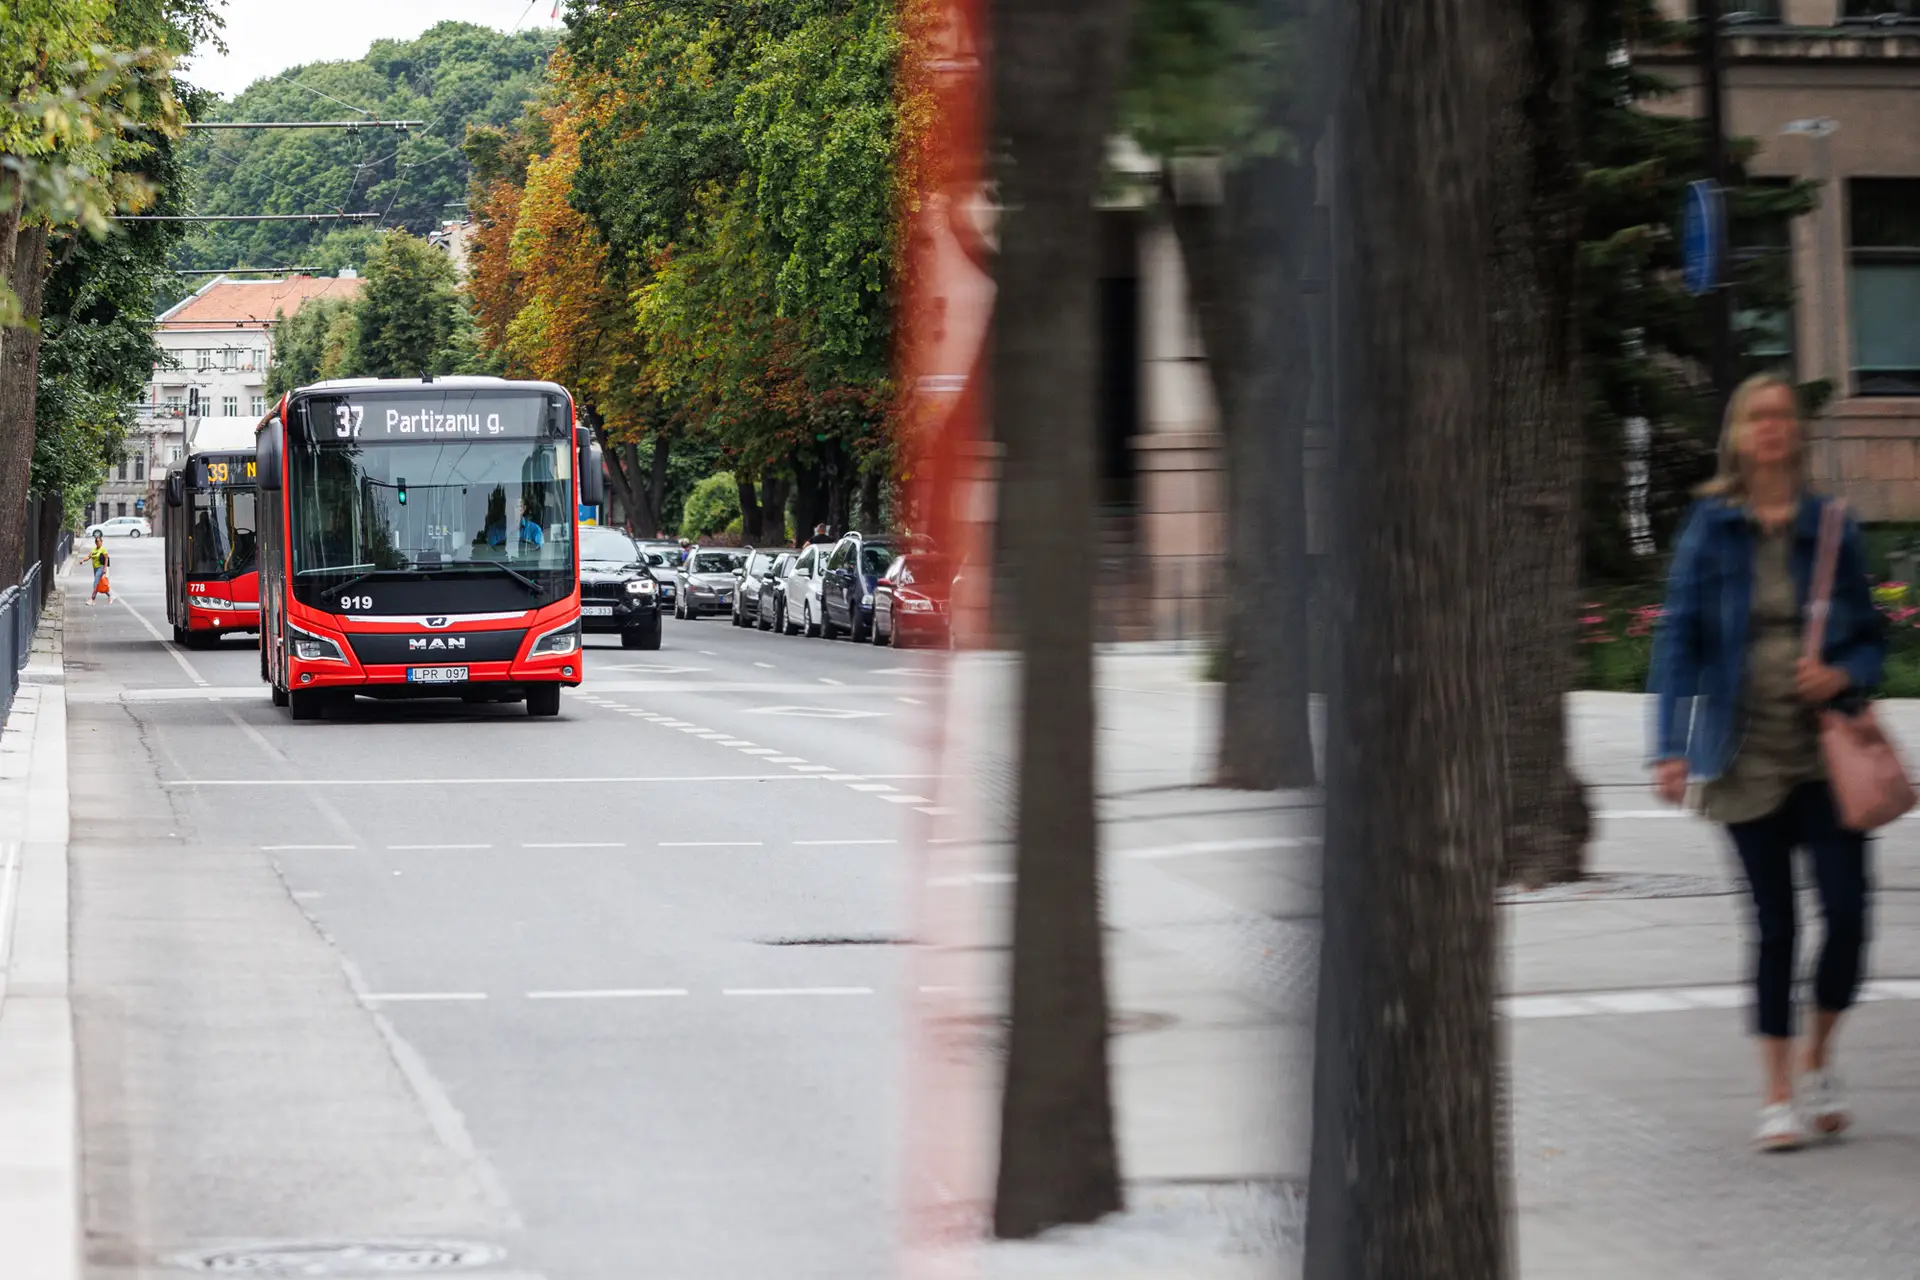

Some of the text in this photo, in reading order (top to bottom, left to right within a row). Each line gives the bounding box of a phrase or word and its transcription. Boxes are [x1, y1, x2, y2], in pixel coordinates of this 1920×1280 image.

[336, 406, 504, 437] 37 Partizanų g.
[208, 463, 228, 482] 39
[190, 583, 205, 592] 778
[340, 596, 373, 609] 919
[582, 607, 594, 615] OG
[409, 638, 466, 650] MAN
[414, 669, 438, 680] LPR
[445, 668, 466, 679] 097
